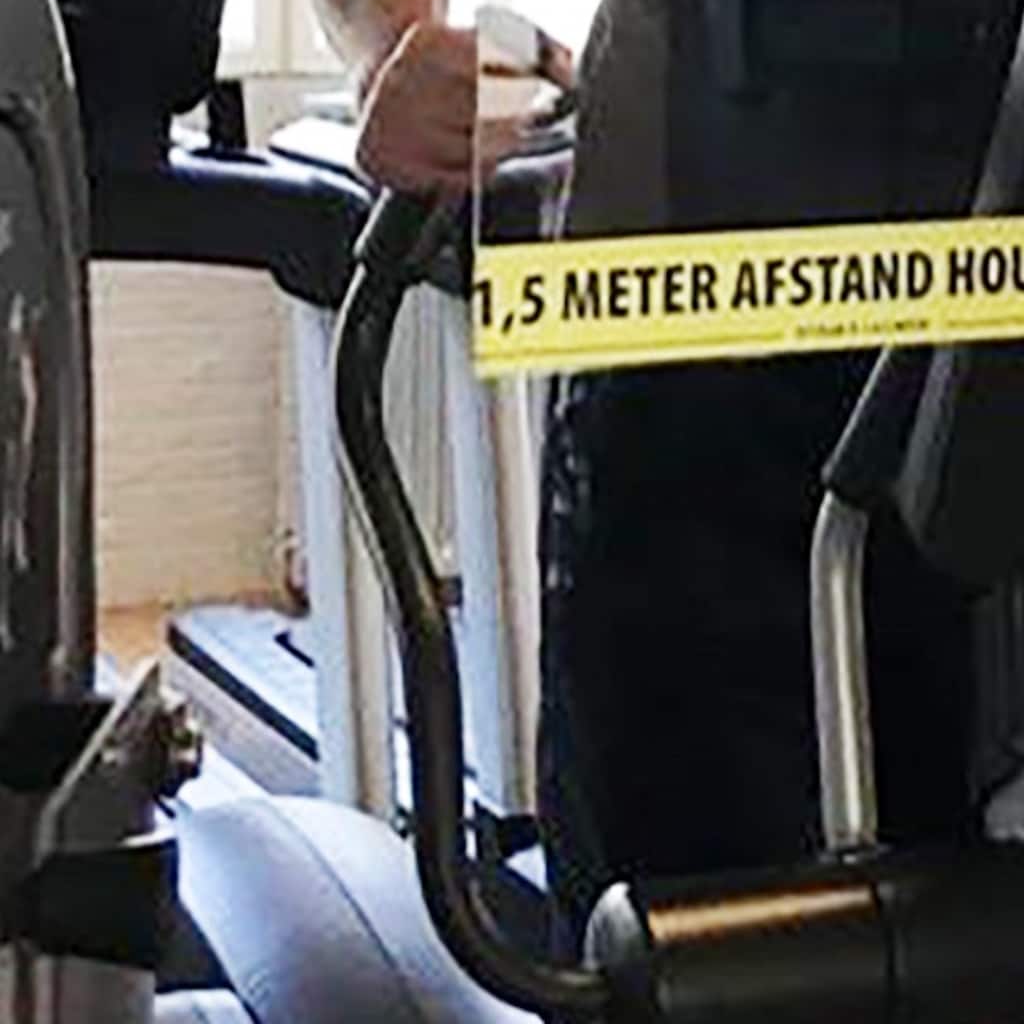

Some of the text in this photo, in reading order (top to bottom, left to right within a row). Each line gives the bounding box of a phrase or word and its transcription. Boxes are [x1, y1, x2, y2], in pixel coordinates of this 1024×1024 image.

[473, 275, 545, 334] 1,5
[562, 263, 717, 320] METER
[730, 251, 934, 309] AFSTAND
